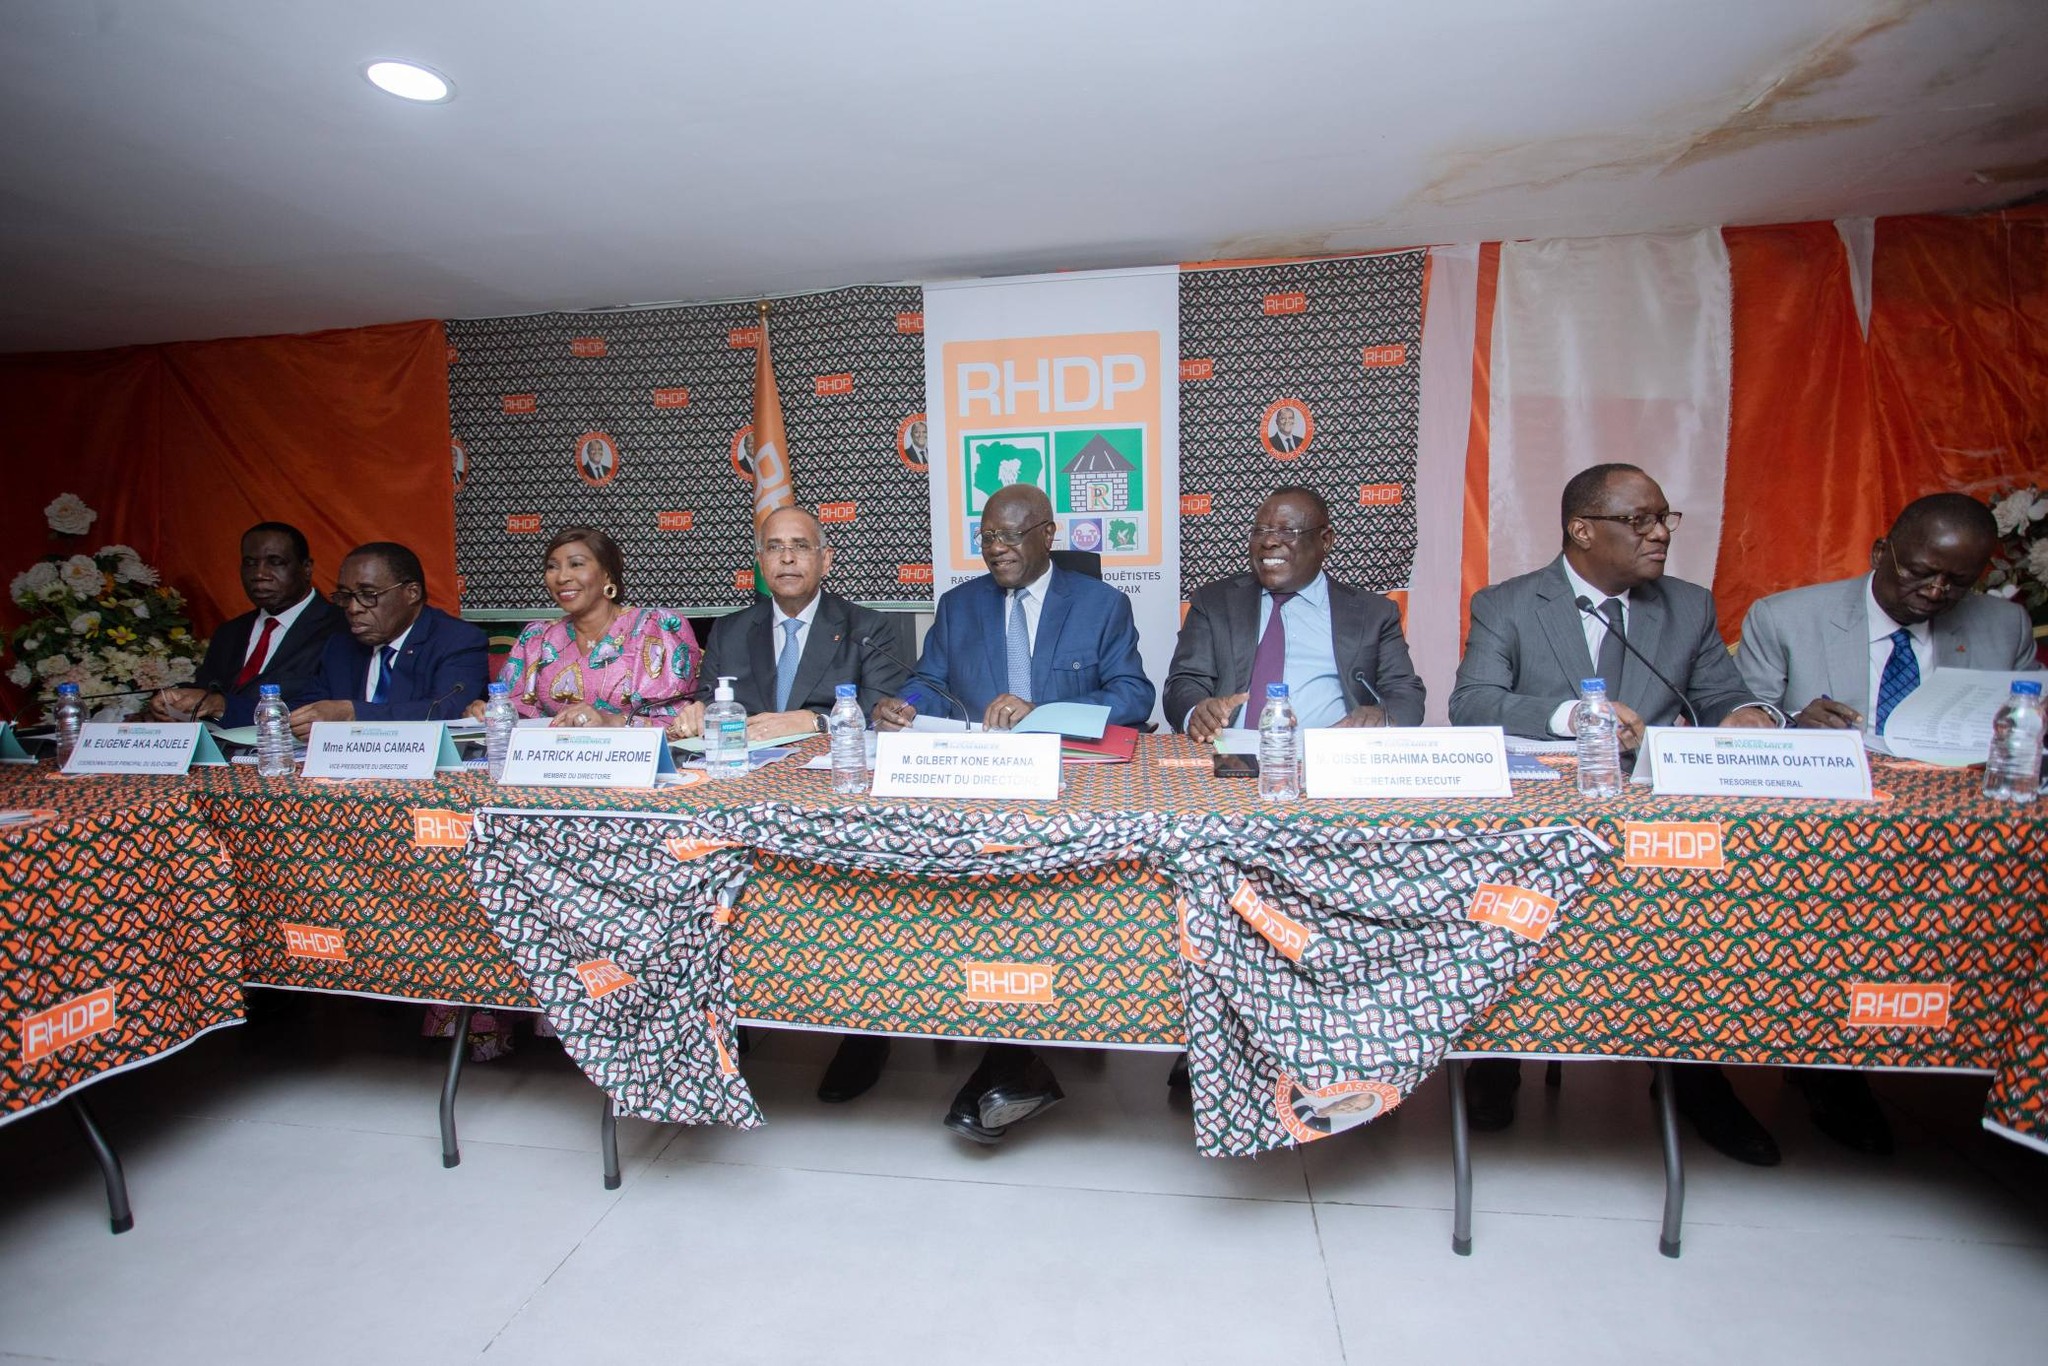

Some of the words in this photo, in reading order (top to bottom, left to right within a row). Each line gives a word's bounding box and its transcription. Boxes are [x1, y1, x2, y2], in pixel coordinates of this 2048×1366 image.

[1266, 297, 1304, 311] RHDP
[899, 317, 924, 329] RHD
[1365, 350, 1402, 363] RHDP
[817, 378, 851, 391] RHDP
[957, 354, 1146, 417] RHDP
[504, 398, 534, 410] RHDP
[656, 392, 687, 404] RHDP
[1362, 488, 1400, 501] RHDP
[1181, 498, 1209, 510] HDP
[821, 507, 854, 519] RHDP
[509, 518, 539, 530] RHDP
[660, 515, 691, 526] RHDP
[737, 574, 754, 584] RH
[1102, 571, 1161, 581] OUËTISTES
[1118, 585, 1141, 593] PAIX
[83, 738, 92, 748] M.
[94, 738, 132, 749] EUGENE
[132, 738, 151, 749] AKA
[152, 738, 190, 749] AOUELE
[322, 742, 343, 753] Mme
[345, 742, 381, 753] KANDIA
[384, 742, 425, 753] CAMARA
[513, 751, 524, 761] M.
[527, 751, 573, 761] PATRICK
[576, 751, 603, 762] ACHI
[605, 751, 651, 762] JEROME
[902, 755, 912, 765] M.
[915, 755, 958, 766] GILBERT
[961, 756, 989, 766] KONE
[992, 756, 1034, 767] KAFANA
[1370, 752, 1428, 764] IBRAHIMA
[1432, 752, 1494, 764] BACONGO
[1663, 752, 1677, 764] M.
[1680, 752, 1714, 765] TENE
[1717, 753, 1779, 766] BIRAHIMA
[1782, 755, 1855, 768] OUATTARA
[890, 773, 951, 785] PRESIDENT
[954, 774, 969, 785] DU
[1414, 776, 1462, 786] EXECUTIF
[1719, 778, 1763, 787] TRESORIER
[1765, 779, 1803, 788] GENERAL
[1629, 831, 1717, 859] RHDP
[1473, 891, 1550, 929] RHDP
[287, 930, 342, 953] RHDP
[971, 970, 1048, 996] RHDP
[1854, 991, 1944, 1018] RHDP
[28, 998, 109, 1054] RHDP
[1277, 1074, 1315, 1141] RESIDENT
